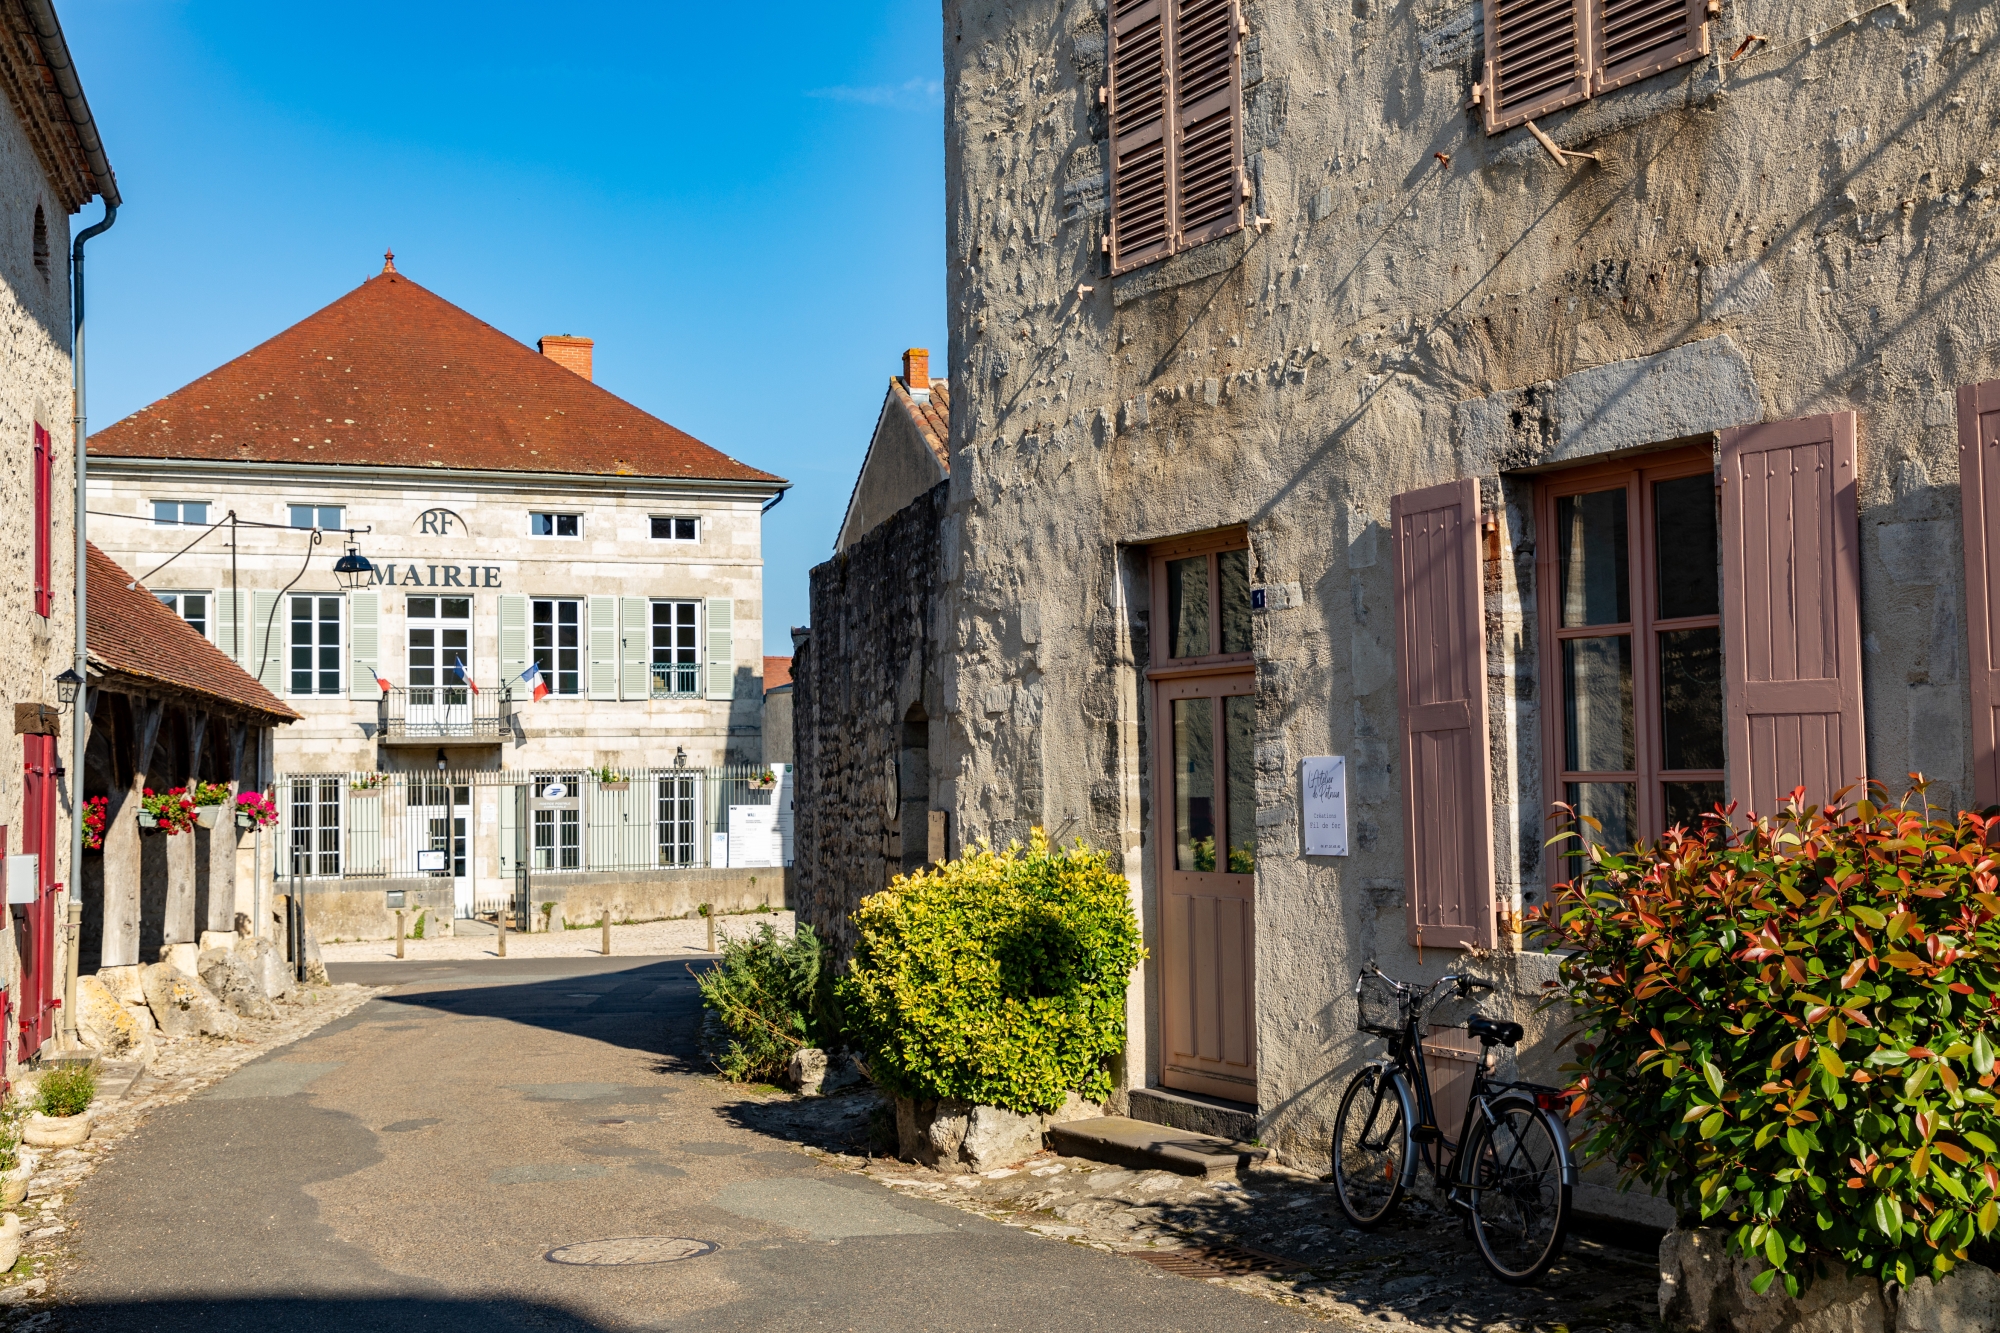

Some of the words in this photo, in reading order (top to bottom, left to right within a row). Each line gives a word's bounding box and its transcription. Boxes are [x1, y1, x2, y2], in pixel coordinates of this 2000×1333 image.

[420, 511, 453, 535] RF
[370, 563, 502, 588] MAIRIE
[1256, 592, 1262, 605] 1
